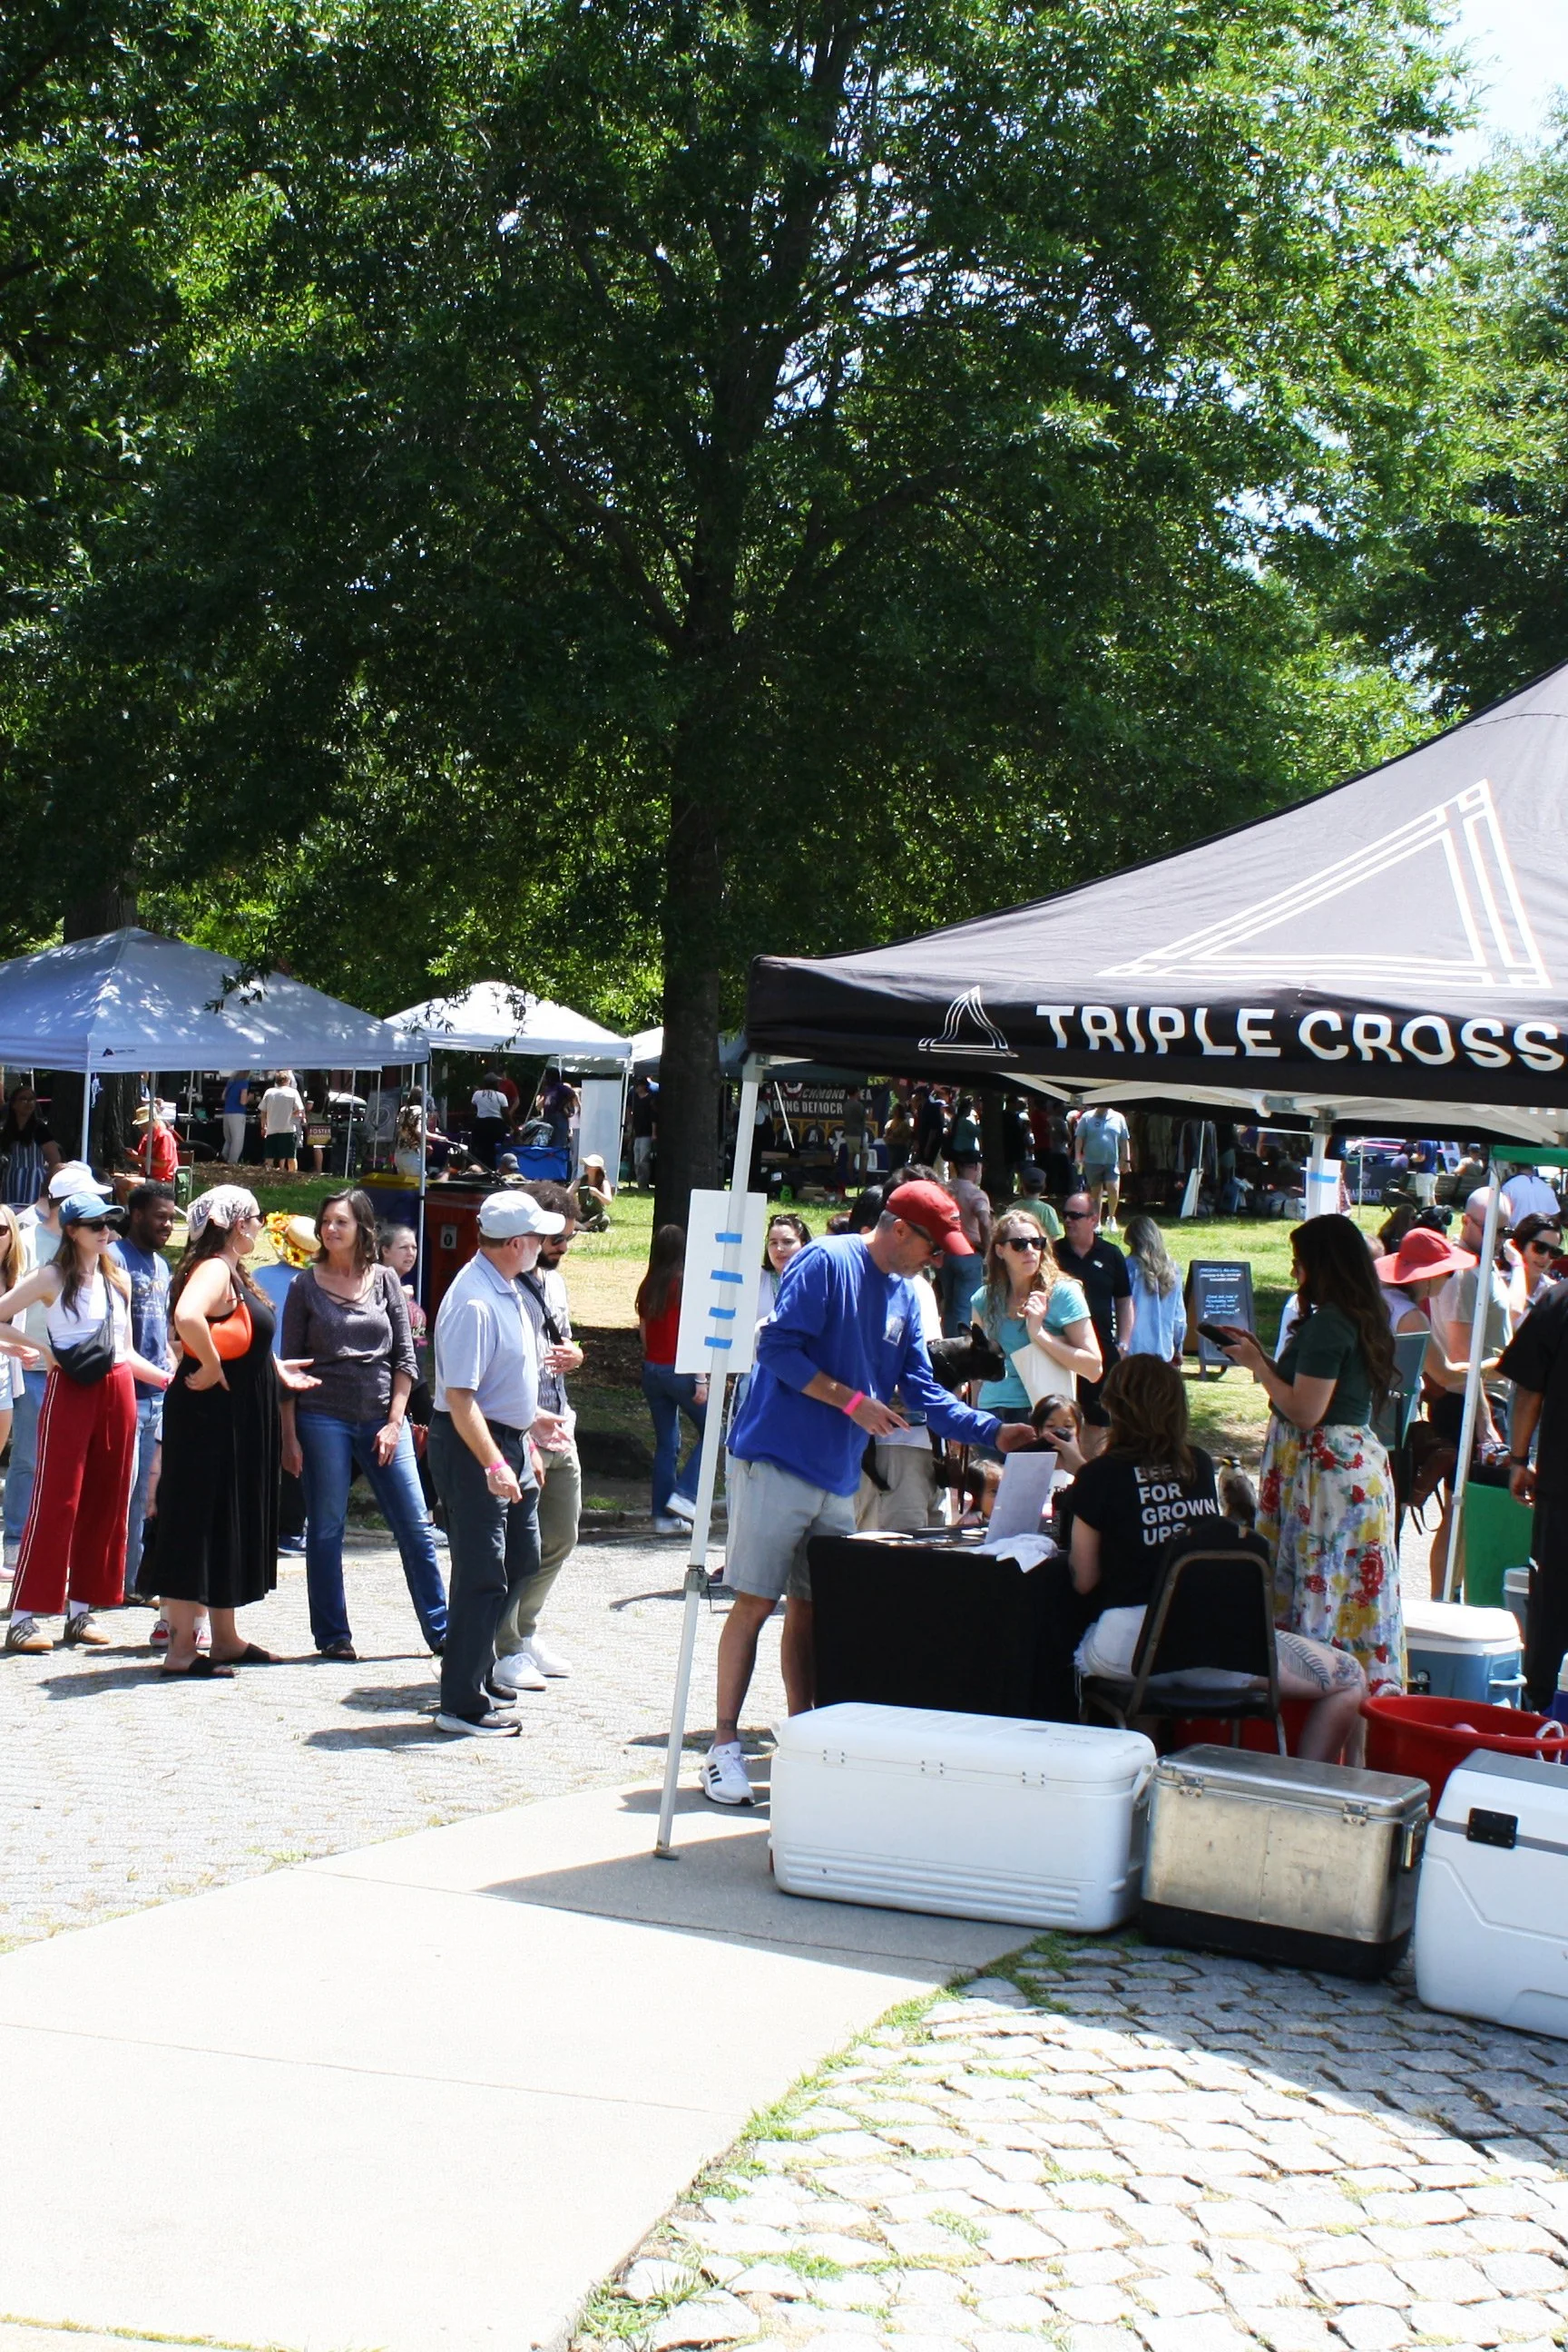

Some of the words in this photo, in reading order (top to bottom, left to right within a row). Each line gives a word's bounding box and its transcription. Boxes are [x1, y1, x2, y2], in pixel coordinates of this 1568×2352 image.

[1035, 1004, 1281, 1057] TRIPLE
[1298, 1009, 1565, 1073] CROSS
[1138, 1482, 1183, 1505] FOR
[1142, 1498, 1217, 1525] GROWN
